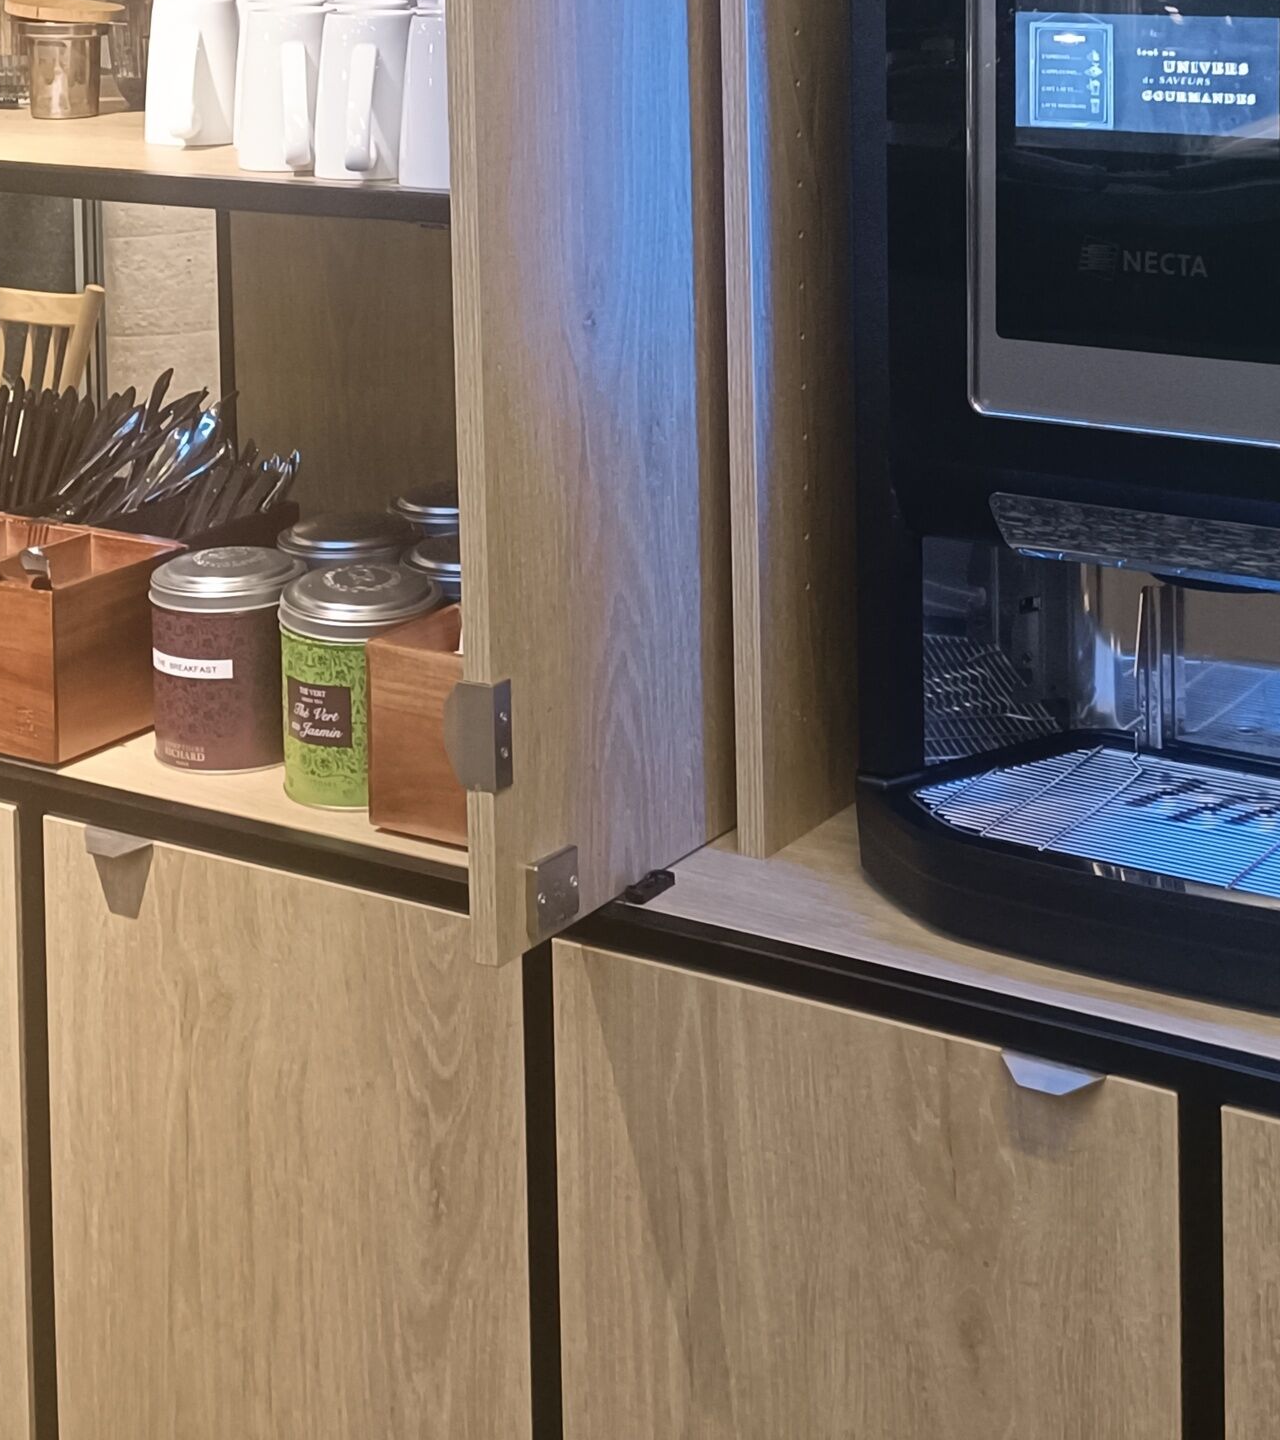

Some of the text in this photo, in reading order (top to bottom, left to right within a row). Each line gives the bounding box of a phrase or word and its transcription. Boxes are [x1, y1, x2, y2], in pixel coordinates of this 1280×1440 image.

[1163, 60, 1249, 76] UNIVERS
[1159, 76, 1211, 86] SAVEURS
[1141, 90, 1256, 105] GOURMANDES
[1122, 250, 1209, 279] NECTA
[169, 662, 217, 674] BREAKFAST
[313, 707, 340, 722] Vert
[300, 722, 343, 738] Jasmin
